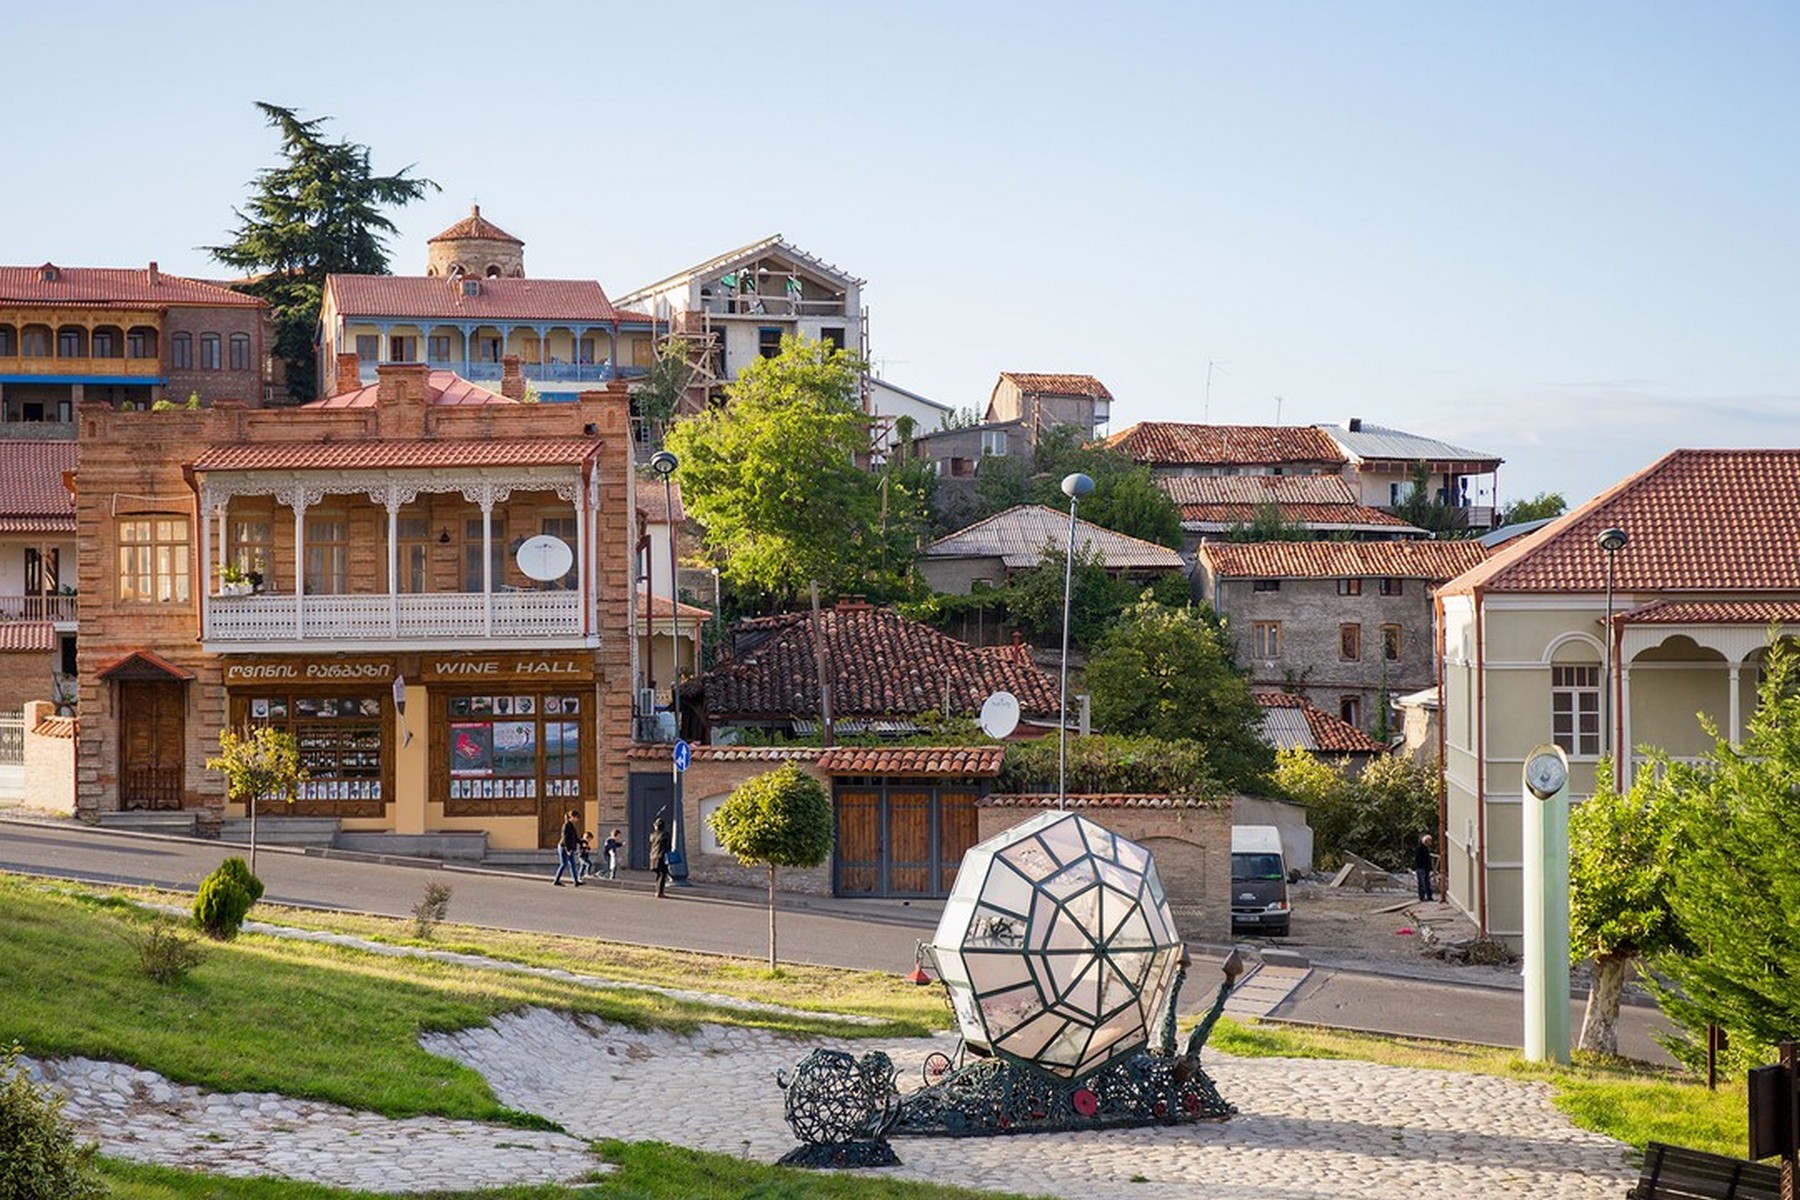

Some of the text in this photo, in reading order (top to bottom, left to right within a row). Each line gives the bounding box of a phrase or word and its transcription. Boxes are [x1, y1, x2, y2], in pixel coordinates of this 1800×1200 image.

[228, 664, 390, 678] ღვინის დარბაზი
[435, 662, 581, 674] WINE HALL
